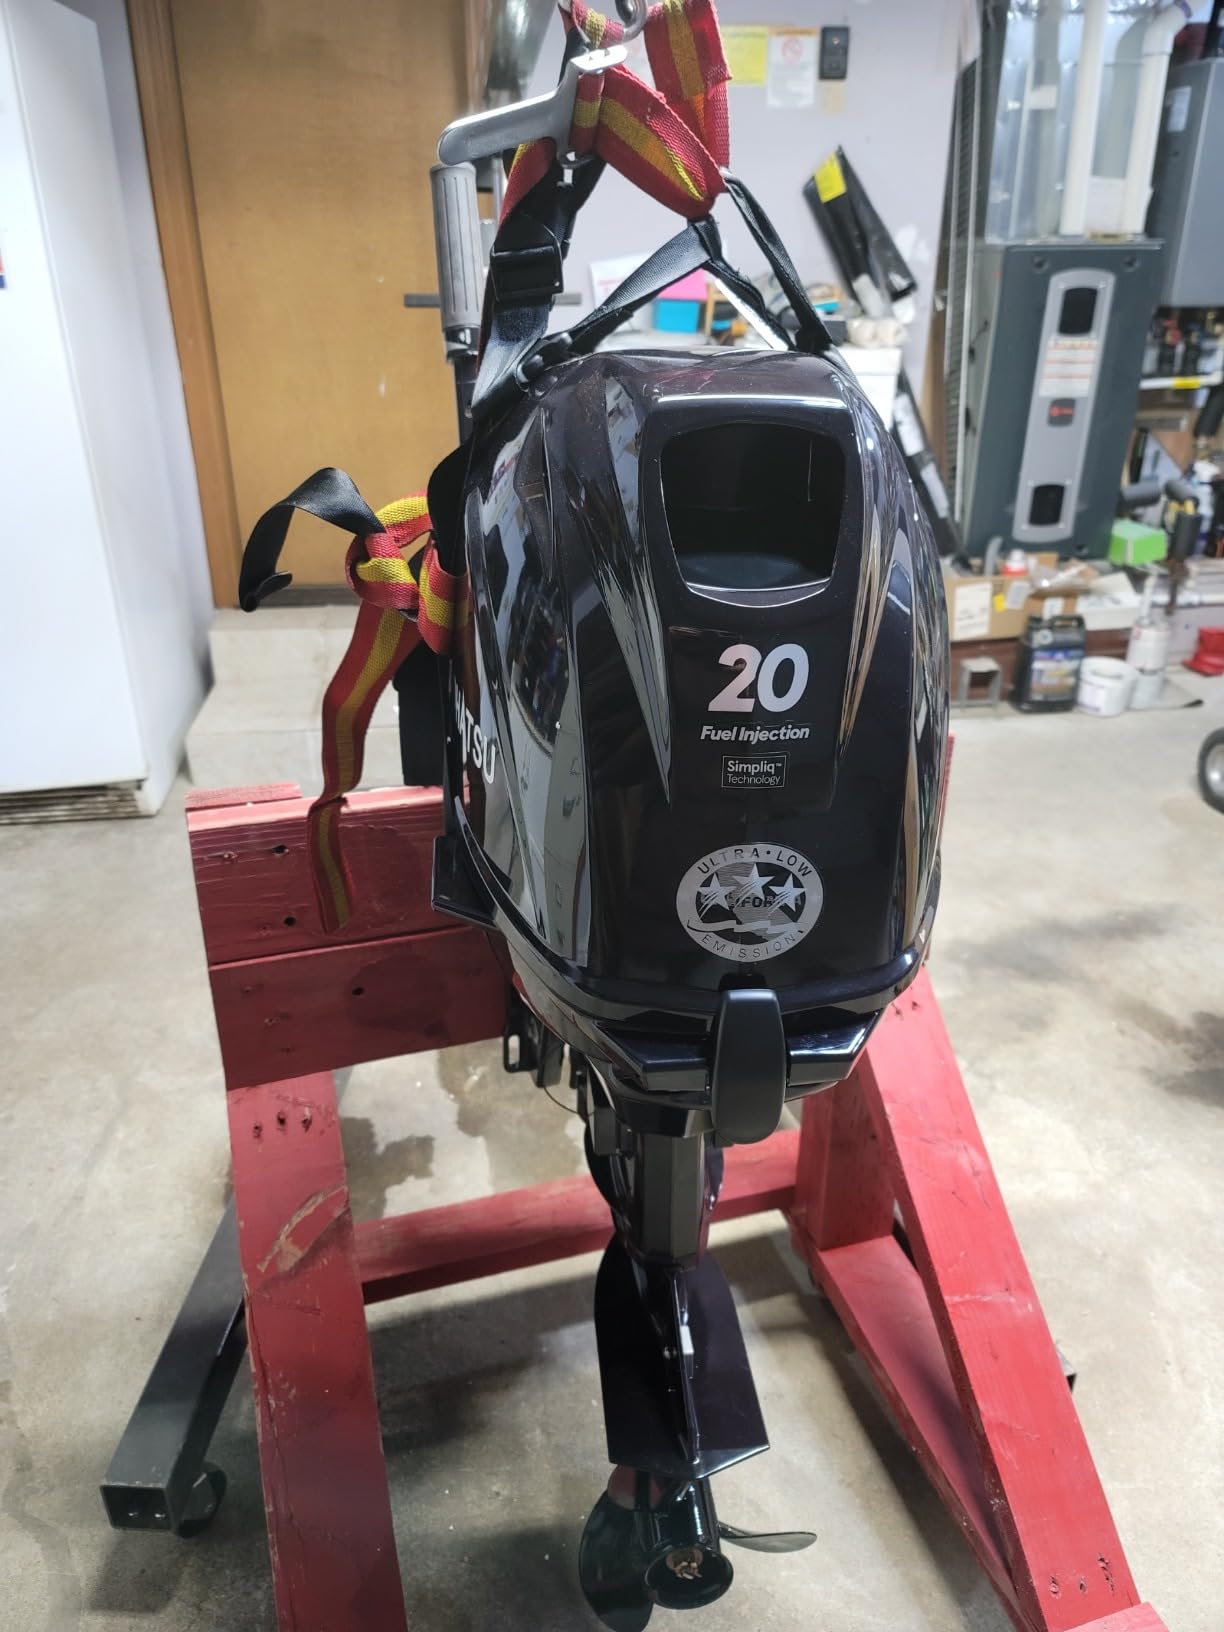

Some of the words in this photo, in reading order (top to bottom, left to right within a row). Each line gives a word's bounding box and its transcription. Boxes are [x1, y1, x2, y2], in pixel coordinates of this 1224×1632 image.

[708, 643, 809, 712] 20
[701, 726, 737, 741] Fuel
[738, 725, 810, 744] Injection
[727, 774, 780, 786] Technology
